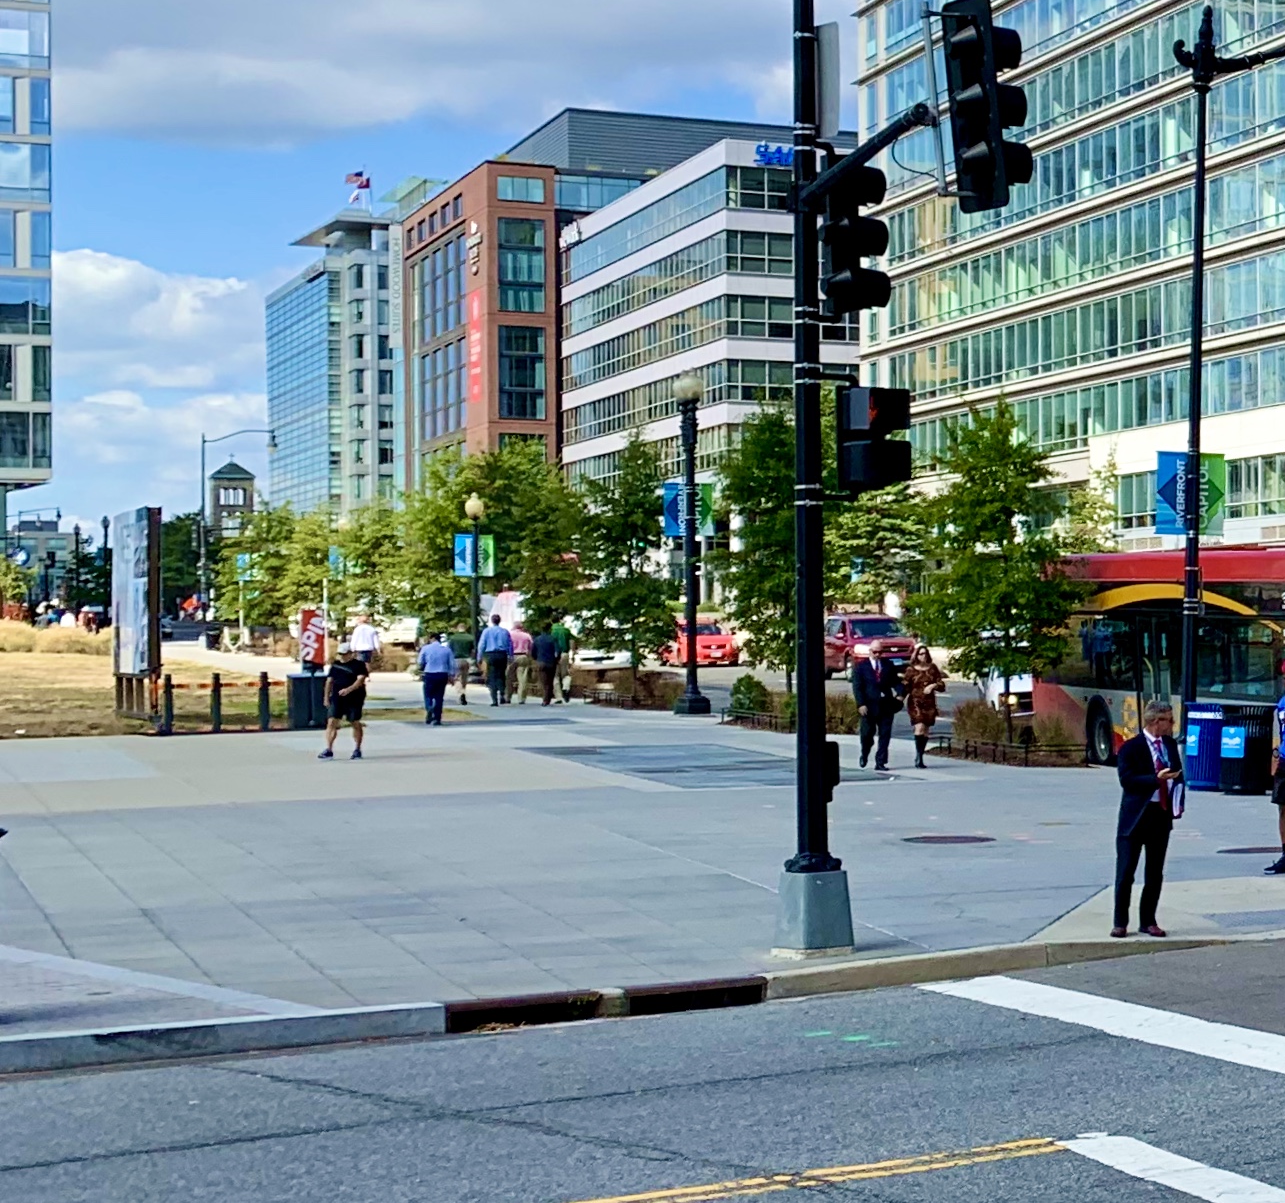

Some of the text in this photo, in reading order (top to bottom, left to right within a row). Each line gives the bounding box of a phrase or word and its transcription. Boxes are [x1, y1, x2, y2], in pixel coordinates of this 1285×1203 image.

[392, 237, 401, 334] HOMEWOOD SUITES
[1175, 458, 1186, 528] RIVERFRONT
[1199, 460, 1209, 529] CAPITOL
